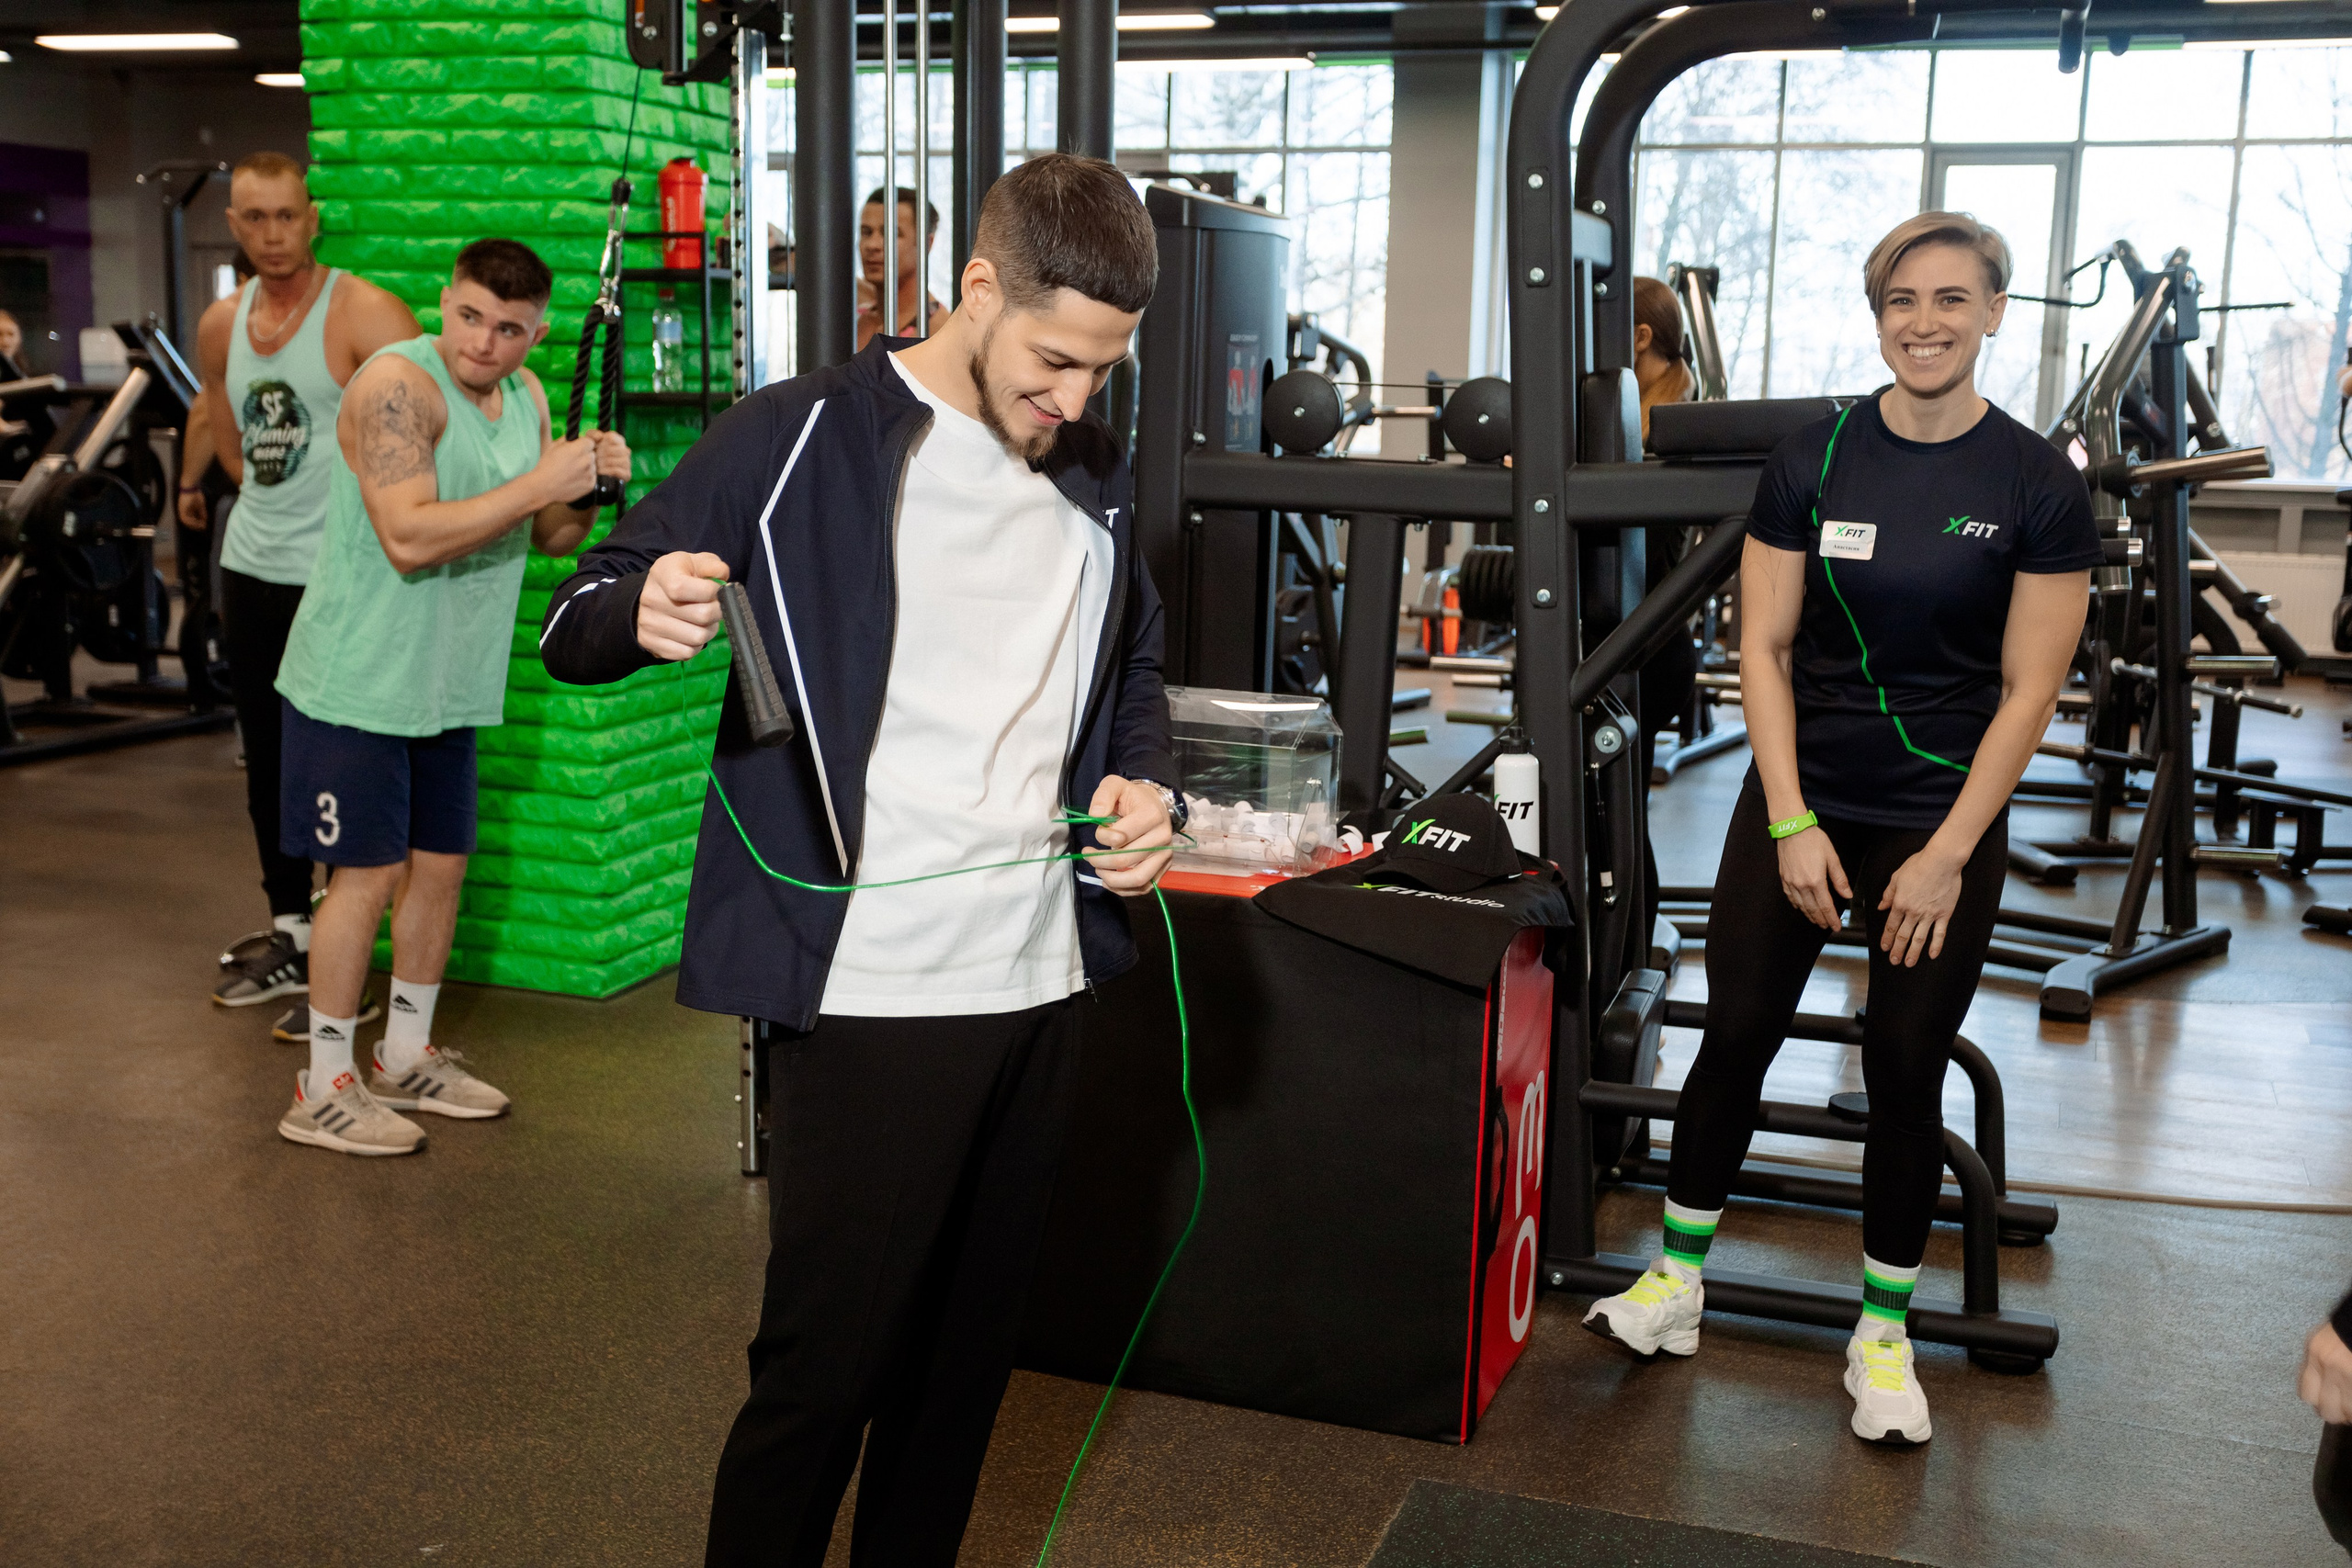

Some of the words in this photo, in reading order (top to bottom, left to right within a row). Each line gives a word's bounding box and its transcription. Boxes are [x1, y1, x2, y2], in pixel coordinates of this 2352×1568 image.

[1835, 525, 1866, 538] XFIT
[1941, 515, 1999, 539] XFIT
[315, 791, 340, 846] 3
[1494, 794, 1534, 819] FIT
[1401, 818, 1471, 852] XFIT
[1778, 819, 1798, 832] XFIT
